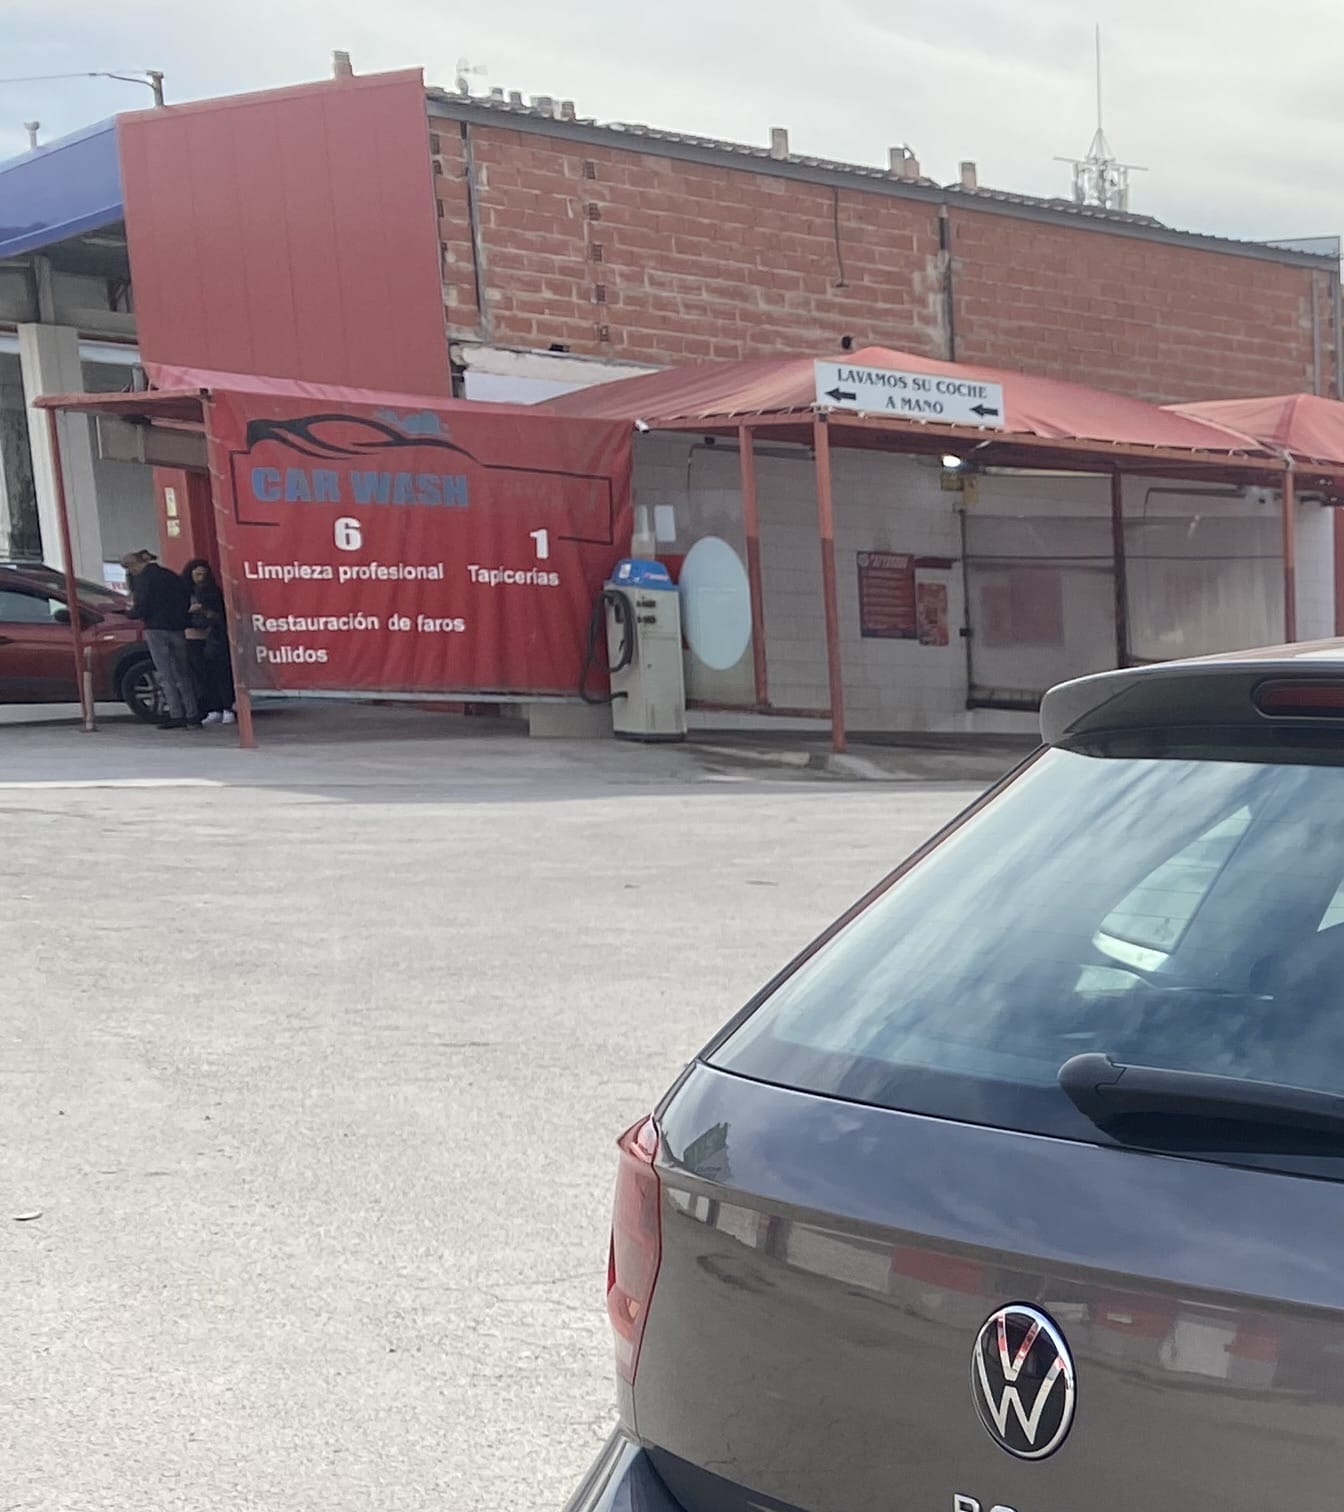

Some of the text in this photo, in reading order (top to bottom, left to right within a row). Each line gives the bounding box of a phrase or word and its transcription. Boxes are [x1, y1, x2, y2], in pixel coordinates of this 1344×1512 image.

[837, 368, 988, 399] LAVAMOS SU COCHE
[885, 396, 944, 414] A MANO
[252, 467, 469, 508] CAR WASH
[333, 517, 363, 551] 6
[529, 529, 549, 559] 1
[243, 561, 444, 583] Limpieza profesional
[252, 612, 466, 632] Restauración de faros
[256, 645, 328, 664] Pulidos
